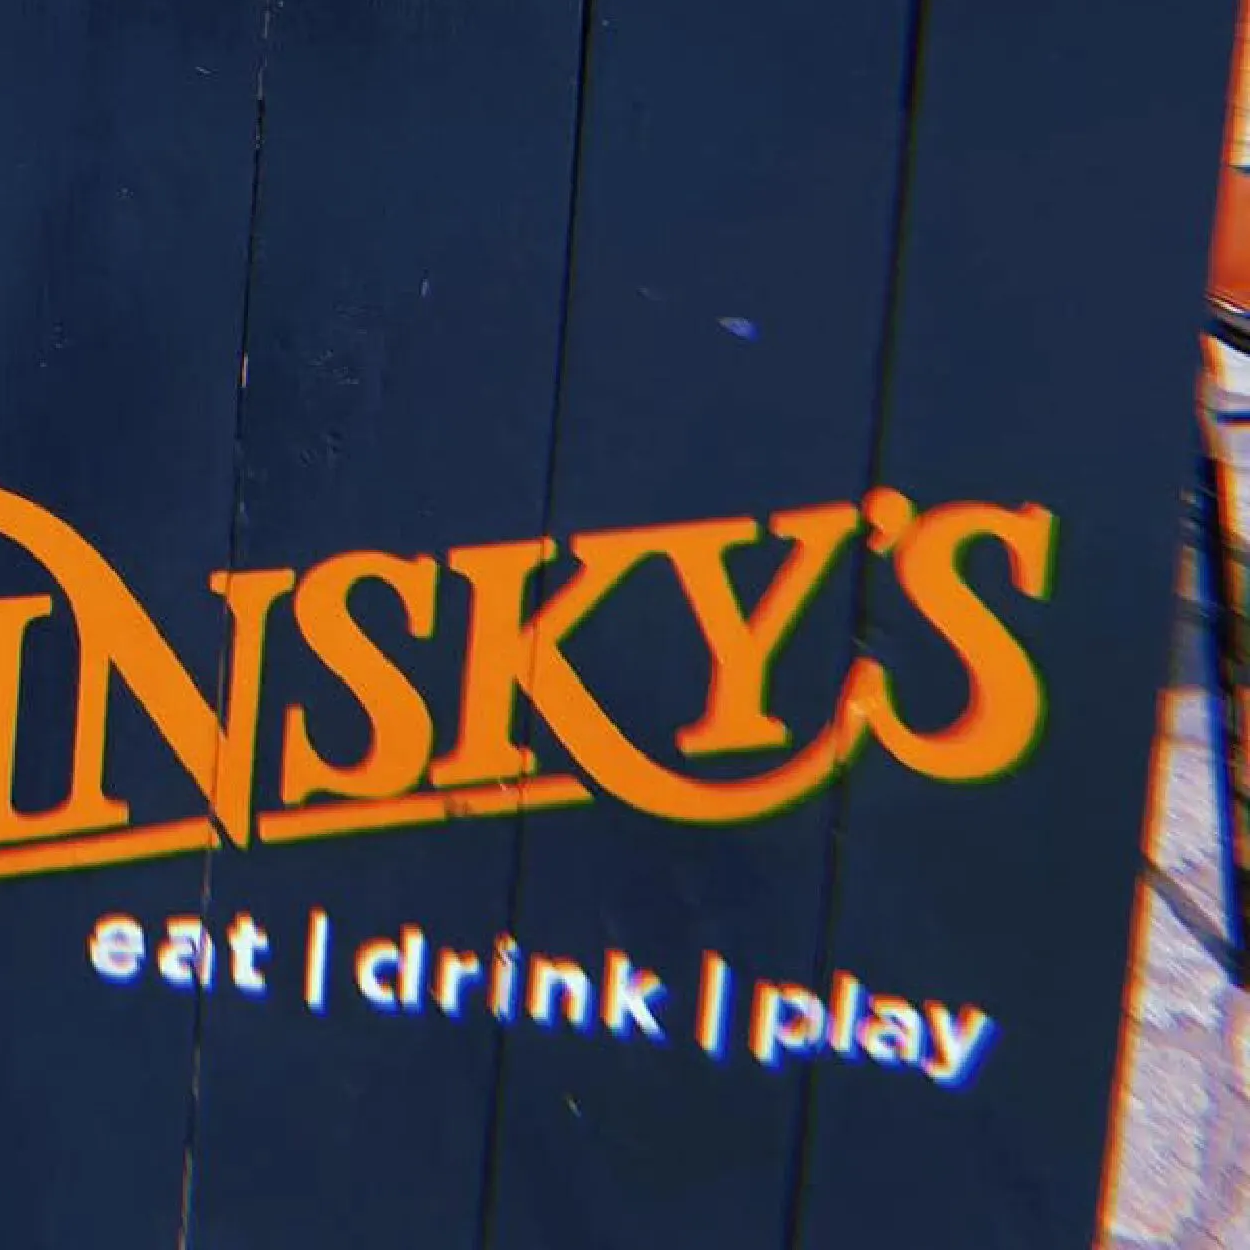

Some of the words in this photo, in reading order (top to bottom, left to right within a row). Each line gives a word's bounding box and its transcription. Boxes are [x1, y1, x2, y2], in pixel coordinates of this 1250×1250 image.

[88, 910, 271, 995] eat
[354, 922, 666, 1039] drink
[750, 968, 995, 1088] play
